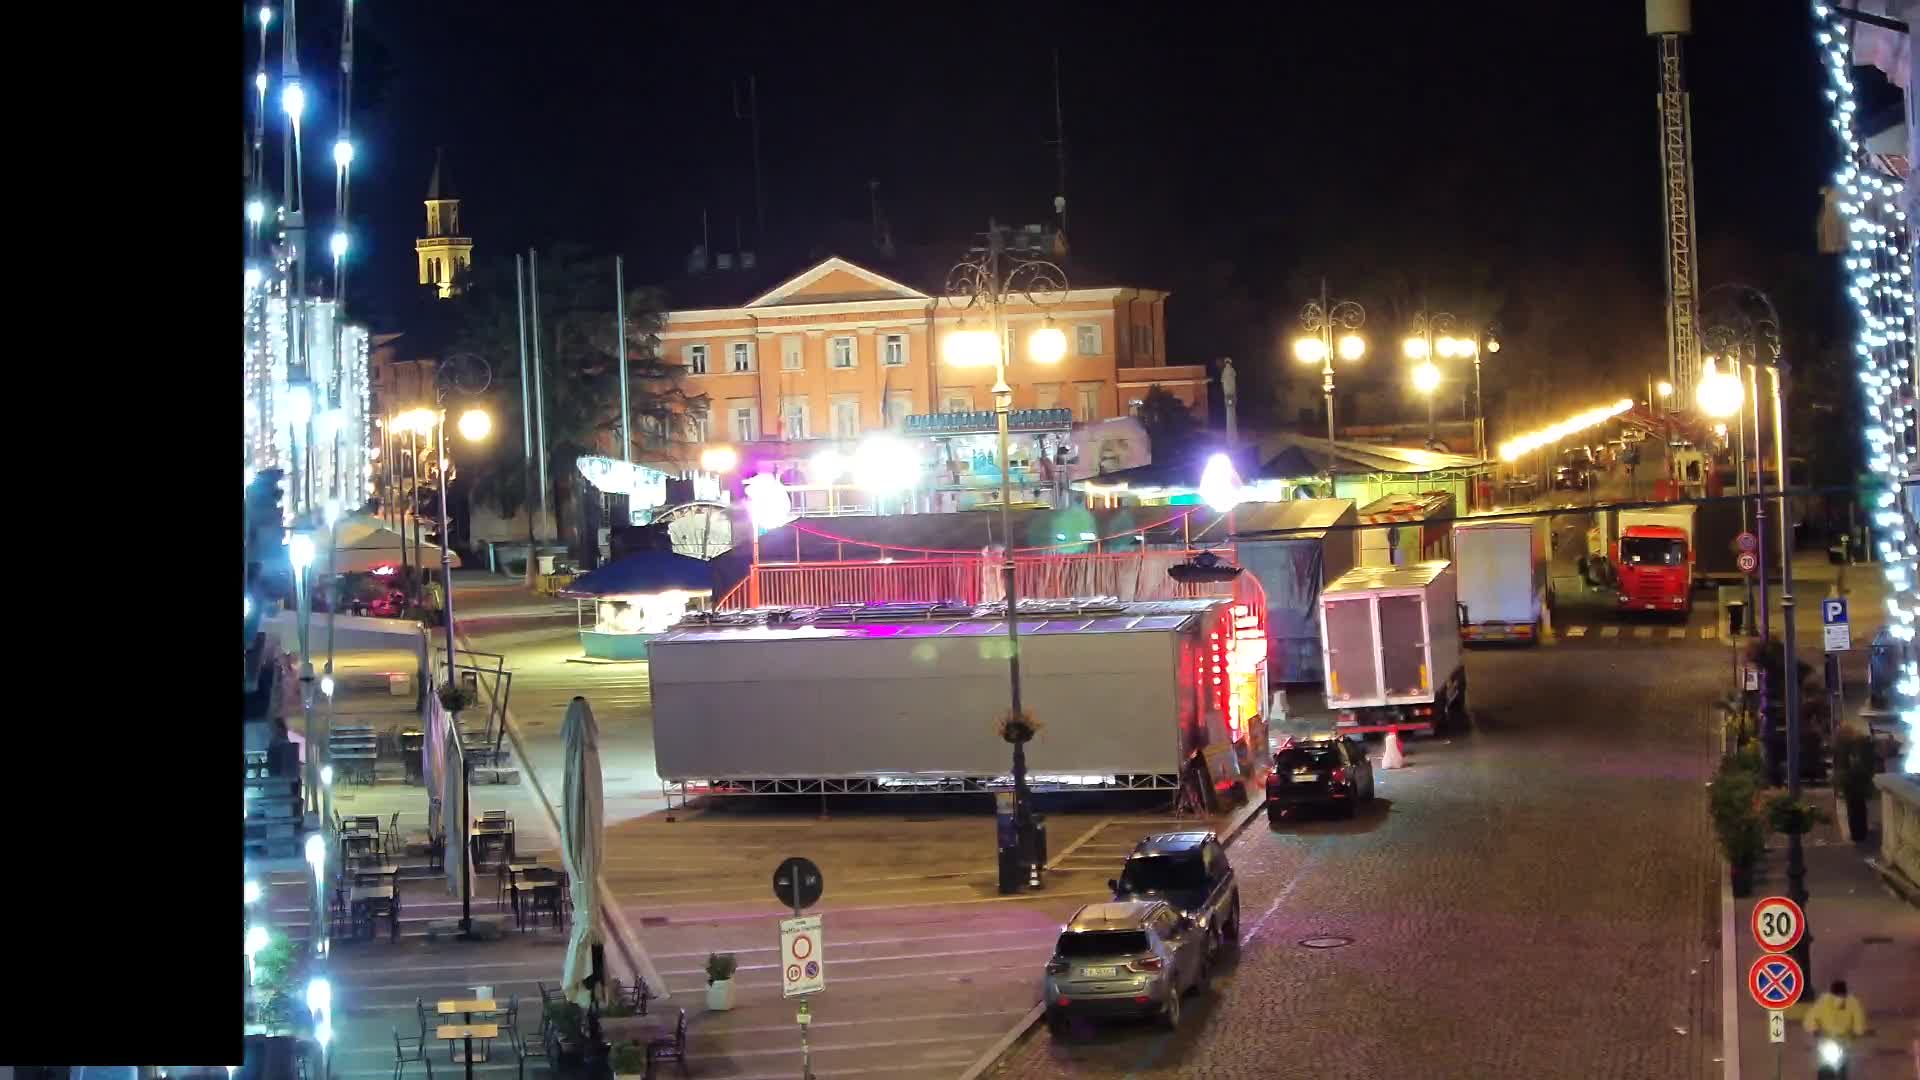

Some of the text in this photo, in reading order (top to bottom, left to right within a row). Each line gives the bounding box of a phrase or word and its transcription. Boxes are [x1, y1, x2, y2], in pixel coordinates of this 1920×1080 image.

[1742, 558, 1753, 567] 20
[1827, 602, 1842, 622] P
[1762, 912, 1791, 938] 30
